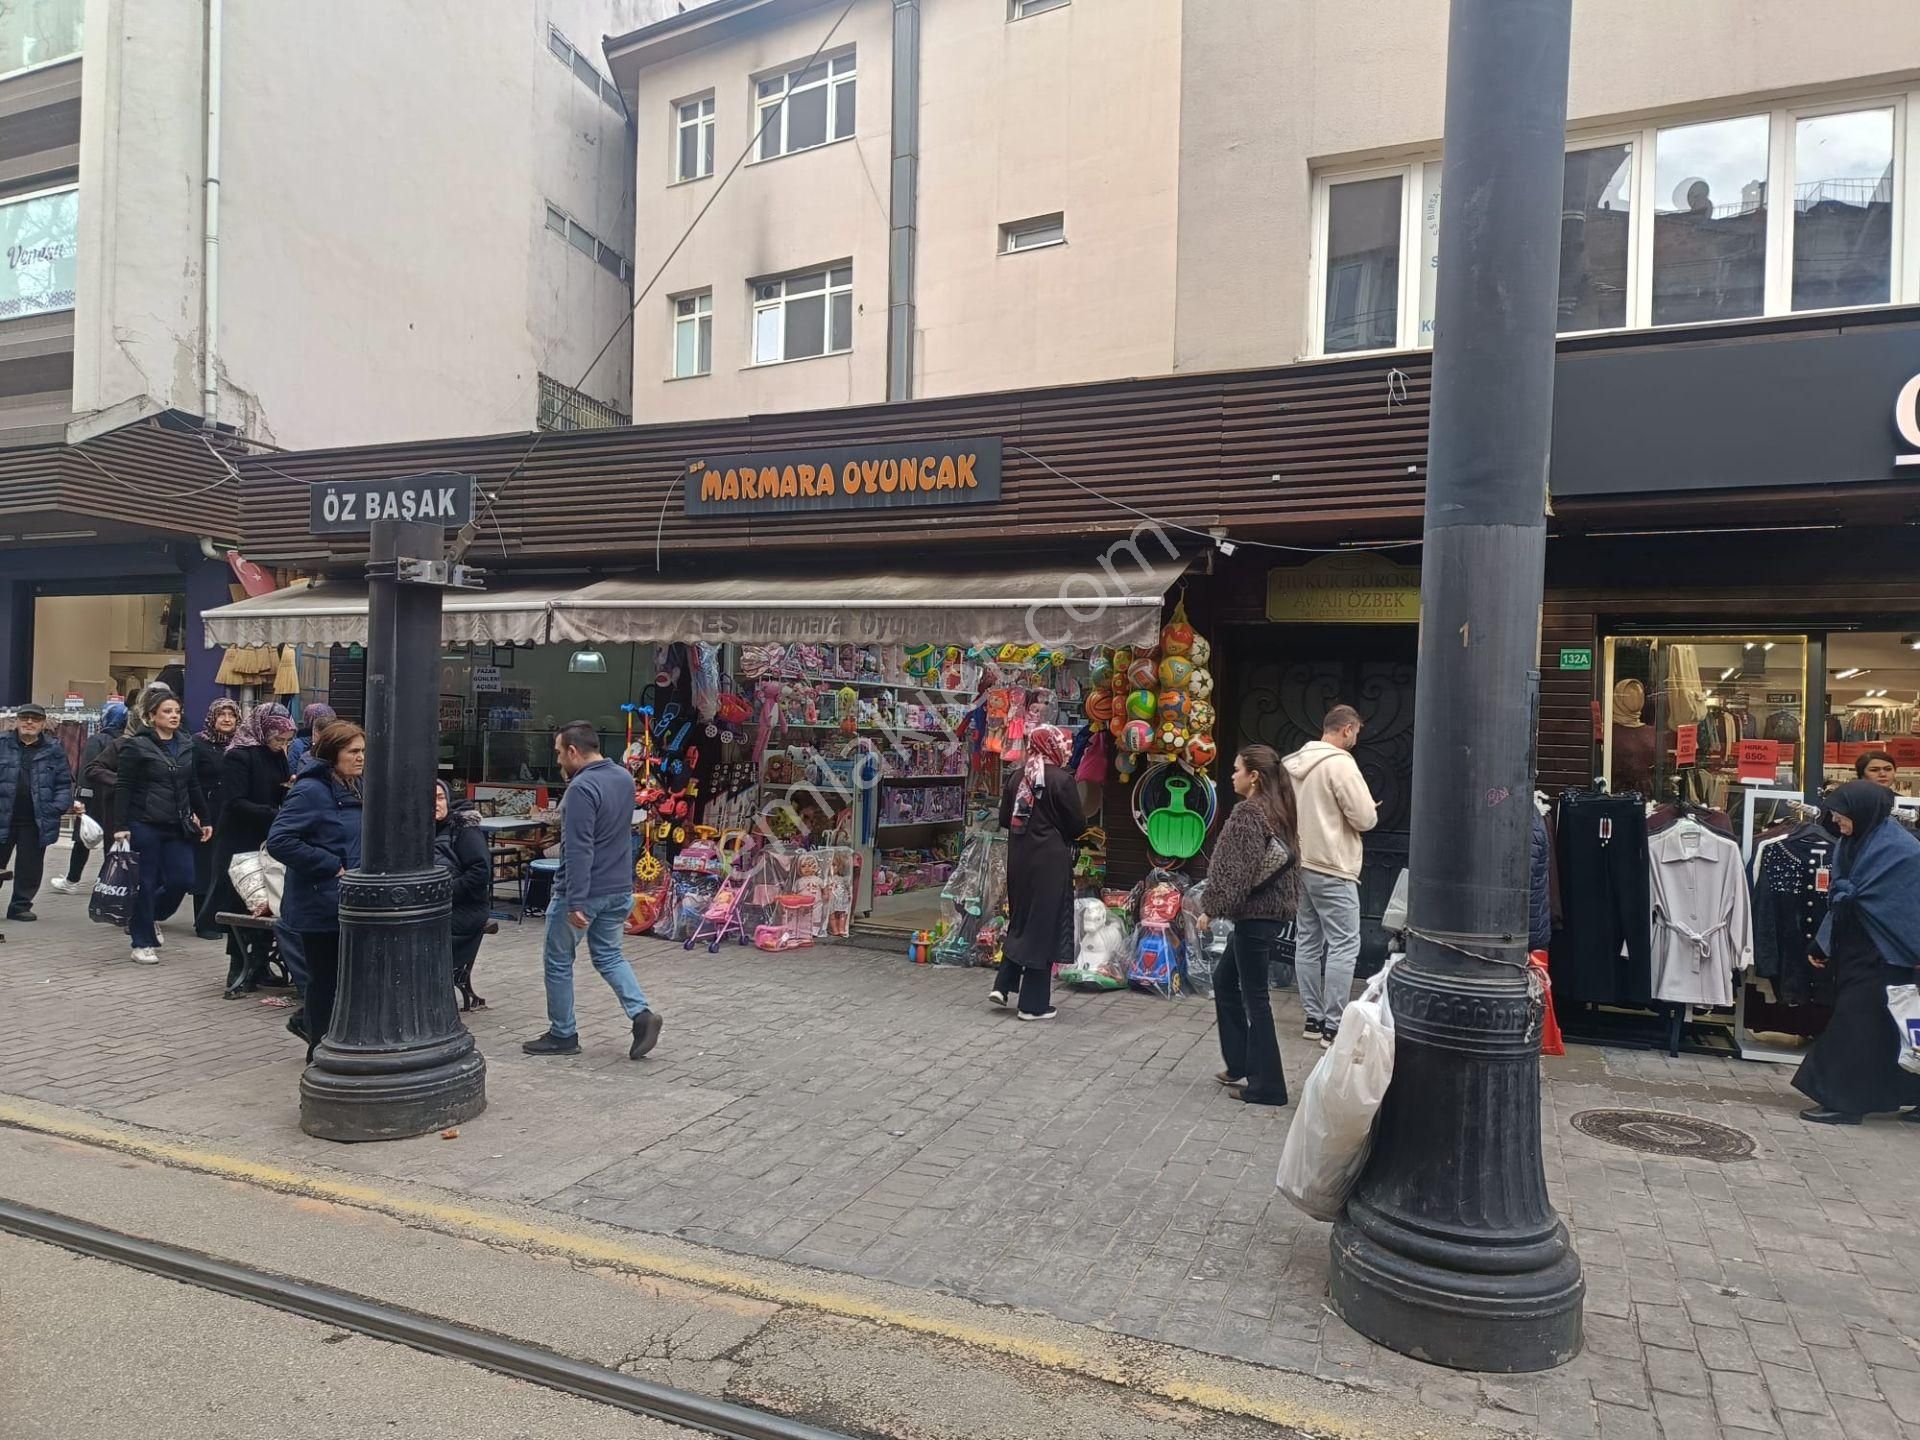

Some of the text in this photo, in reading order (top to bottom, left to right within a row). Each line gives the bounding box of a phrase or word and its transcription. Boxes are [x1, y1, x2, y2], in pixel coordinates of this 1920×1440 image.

[701, 453, 978, 501] MARMARA OYUNCAK
[323, 487, 457, 522] ÖZ BAŞAK
[1321, 593, 1342, 608] Ali
[1348, 590, 1406, 608] ÖZBEK
[701, 610, 960, 640] ES Marmara Oyuncak
[1459, 621, 1471, 647] 1
[1562, 654, 1589, 664] 132A
